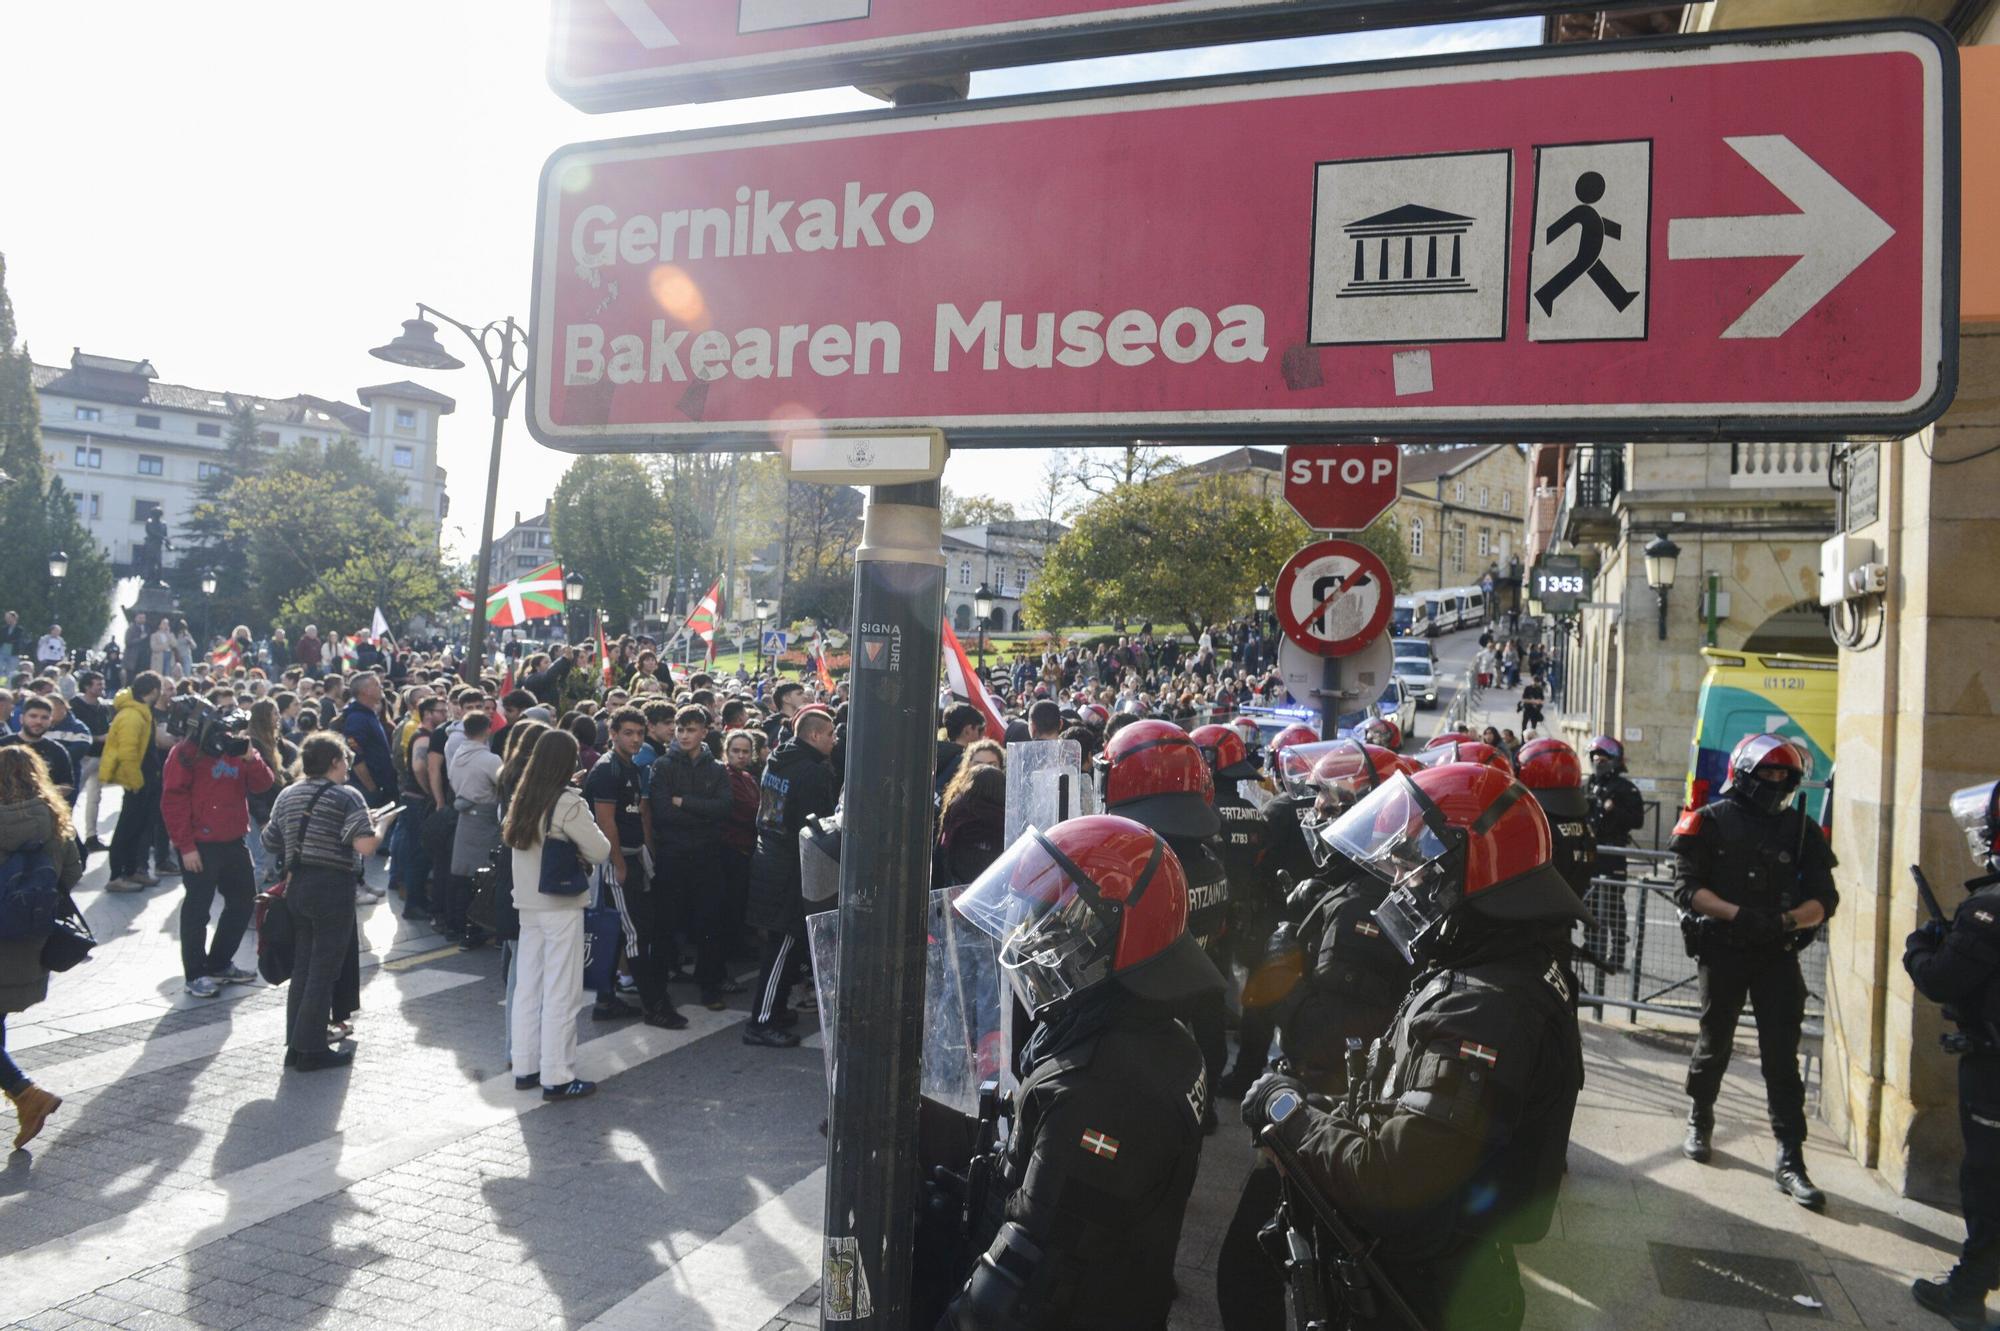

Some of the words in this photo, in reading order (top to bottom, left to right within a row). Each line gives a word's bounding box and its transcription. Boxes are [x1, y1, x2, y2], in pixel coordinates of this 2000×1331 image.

[571, 182, 935, 268] Gernikako
[563, 319, 901, 387] Bakearen
[933, 301, 1269, 373] Museoa
[1291, 459, 1392, 484] STOP
[1538, 576, 1583, 592] 13:53
[1189, 879, 1228, 911] RTZAINTZ
